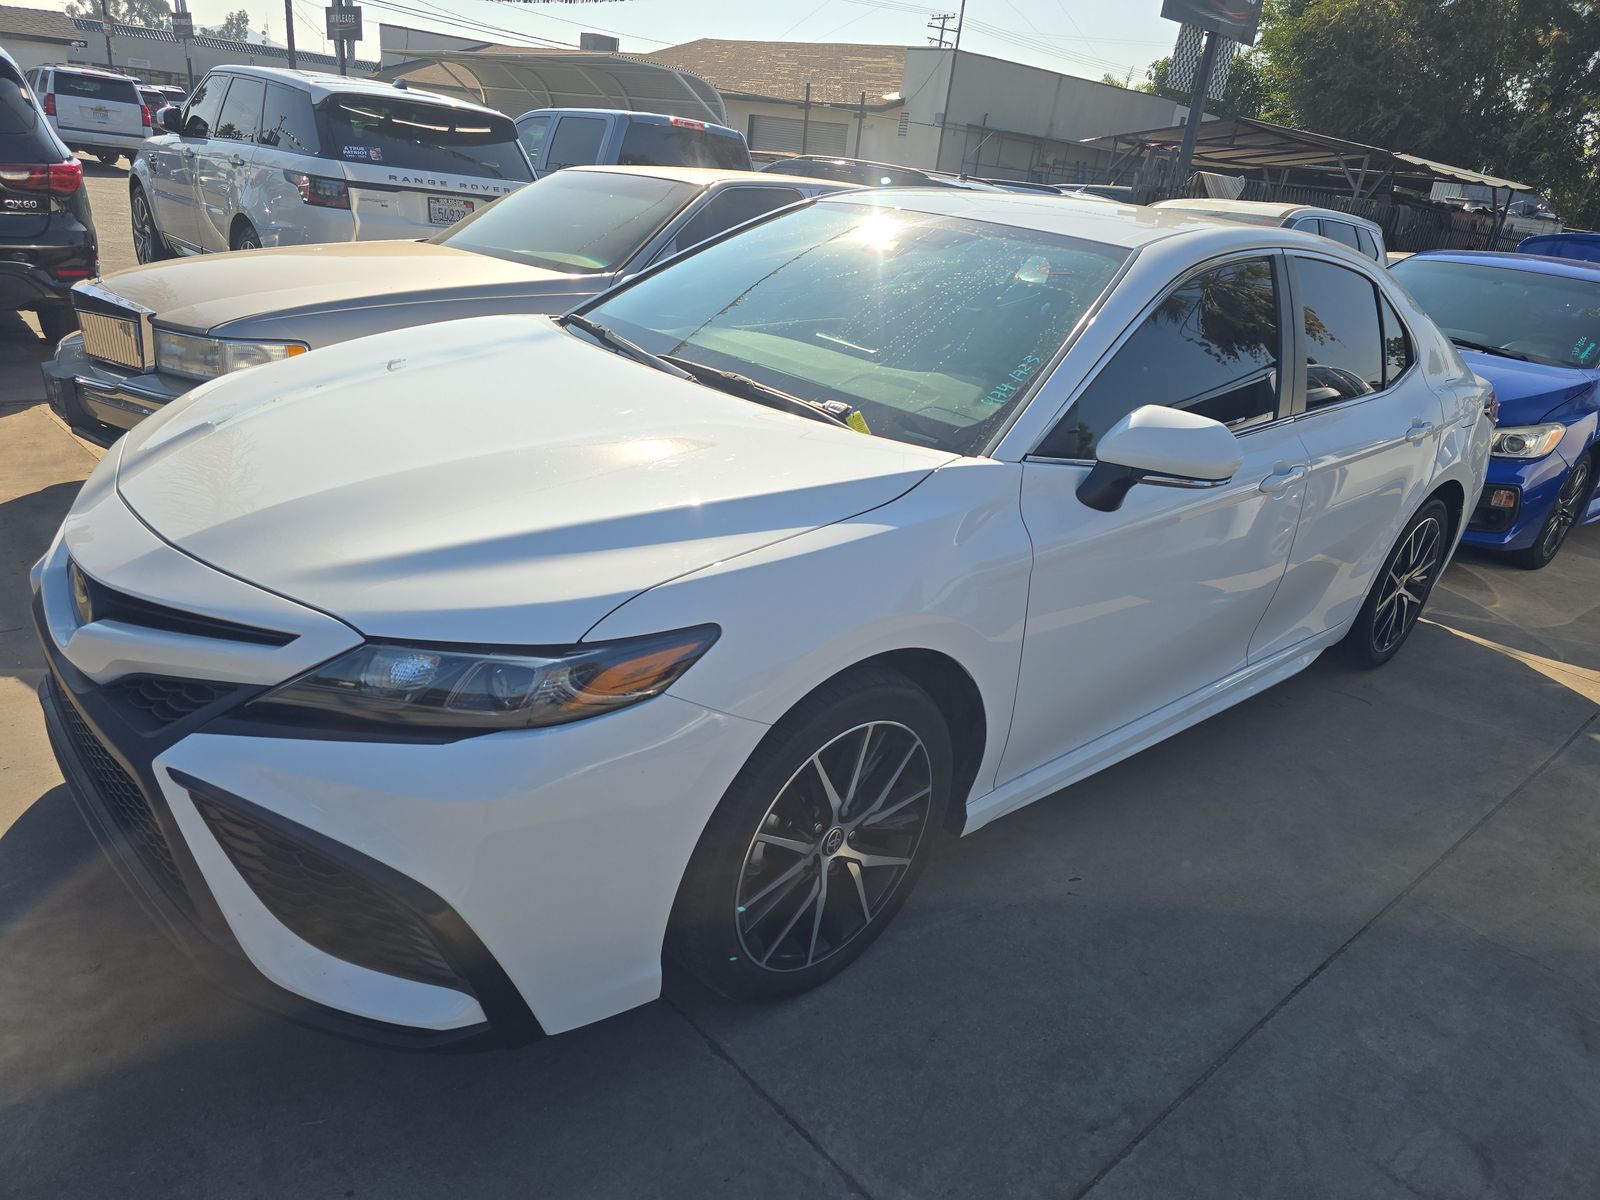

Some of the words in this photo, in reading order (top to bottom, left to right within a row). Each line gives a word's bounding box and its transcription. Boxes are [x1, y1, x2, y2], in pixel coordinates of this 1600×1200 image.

[388, 174, 448, 187] RANGE
[459, 182, 510, 193] ROVER
[4, 199, 37, 209] QX60
